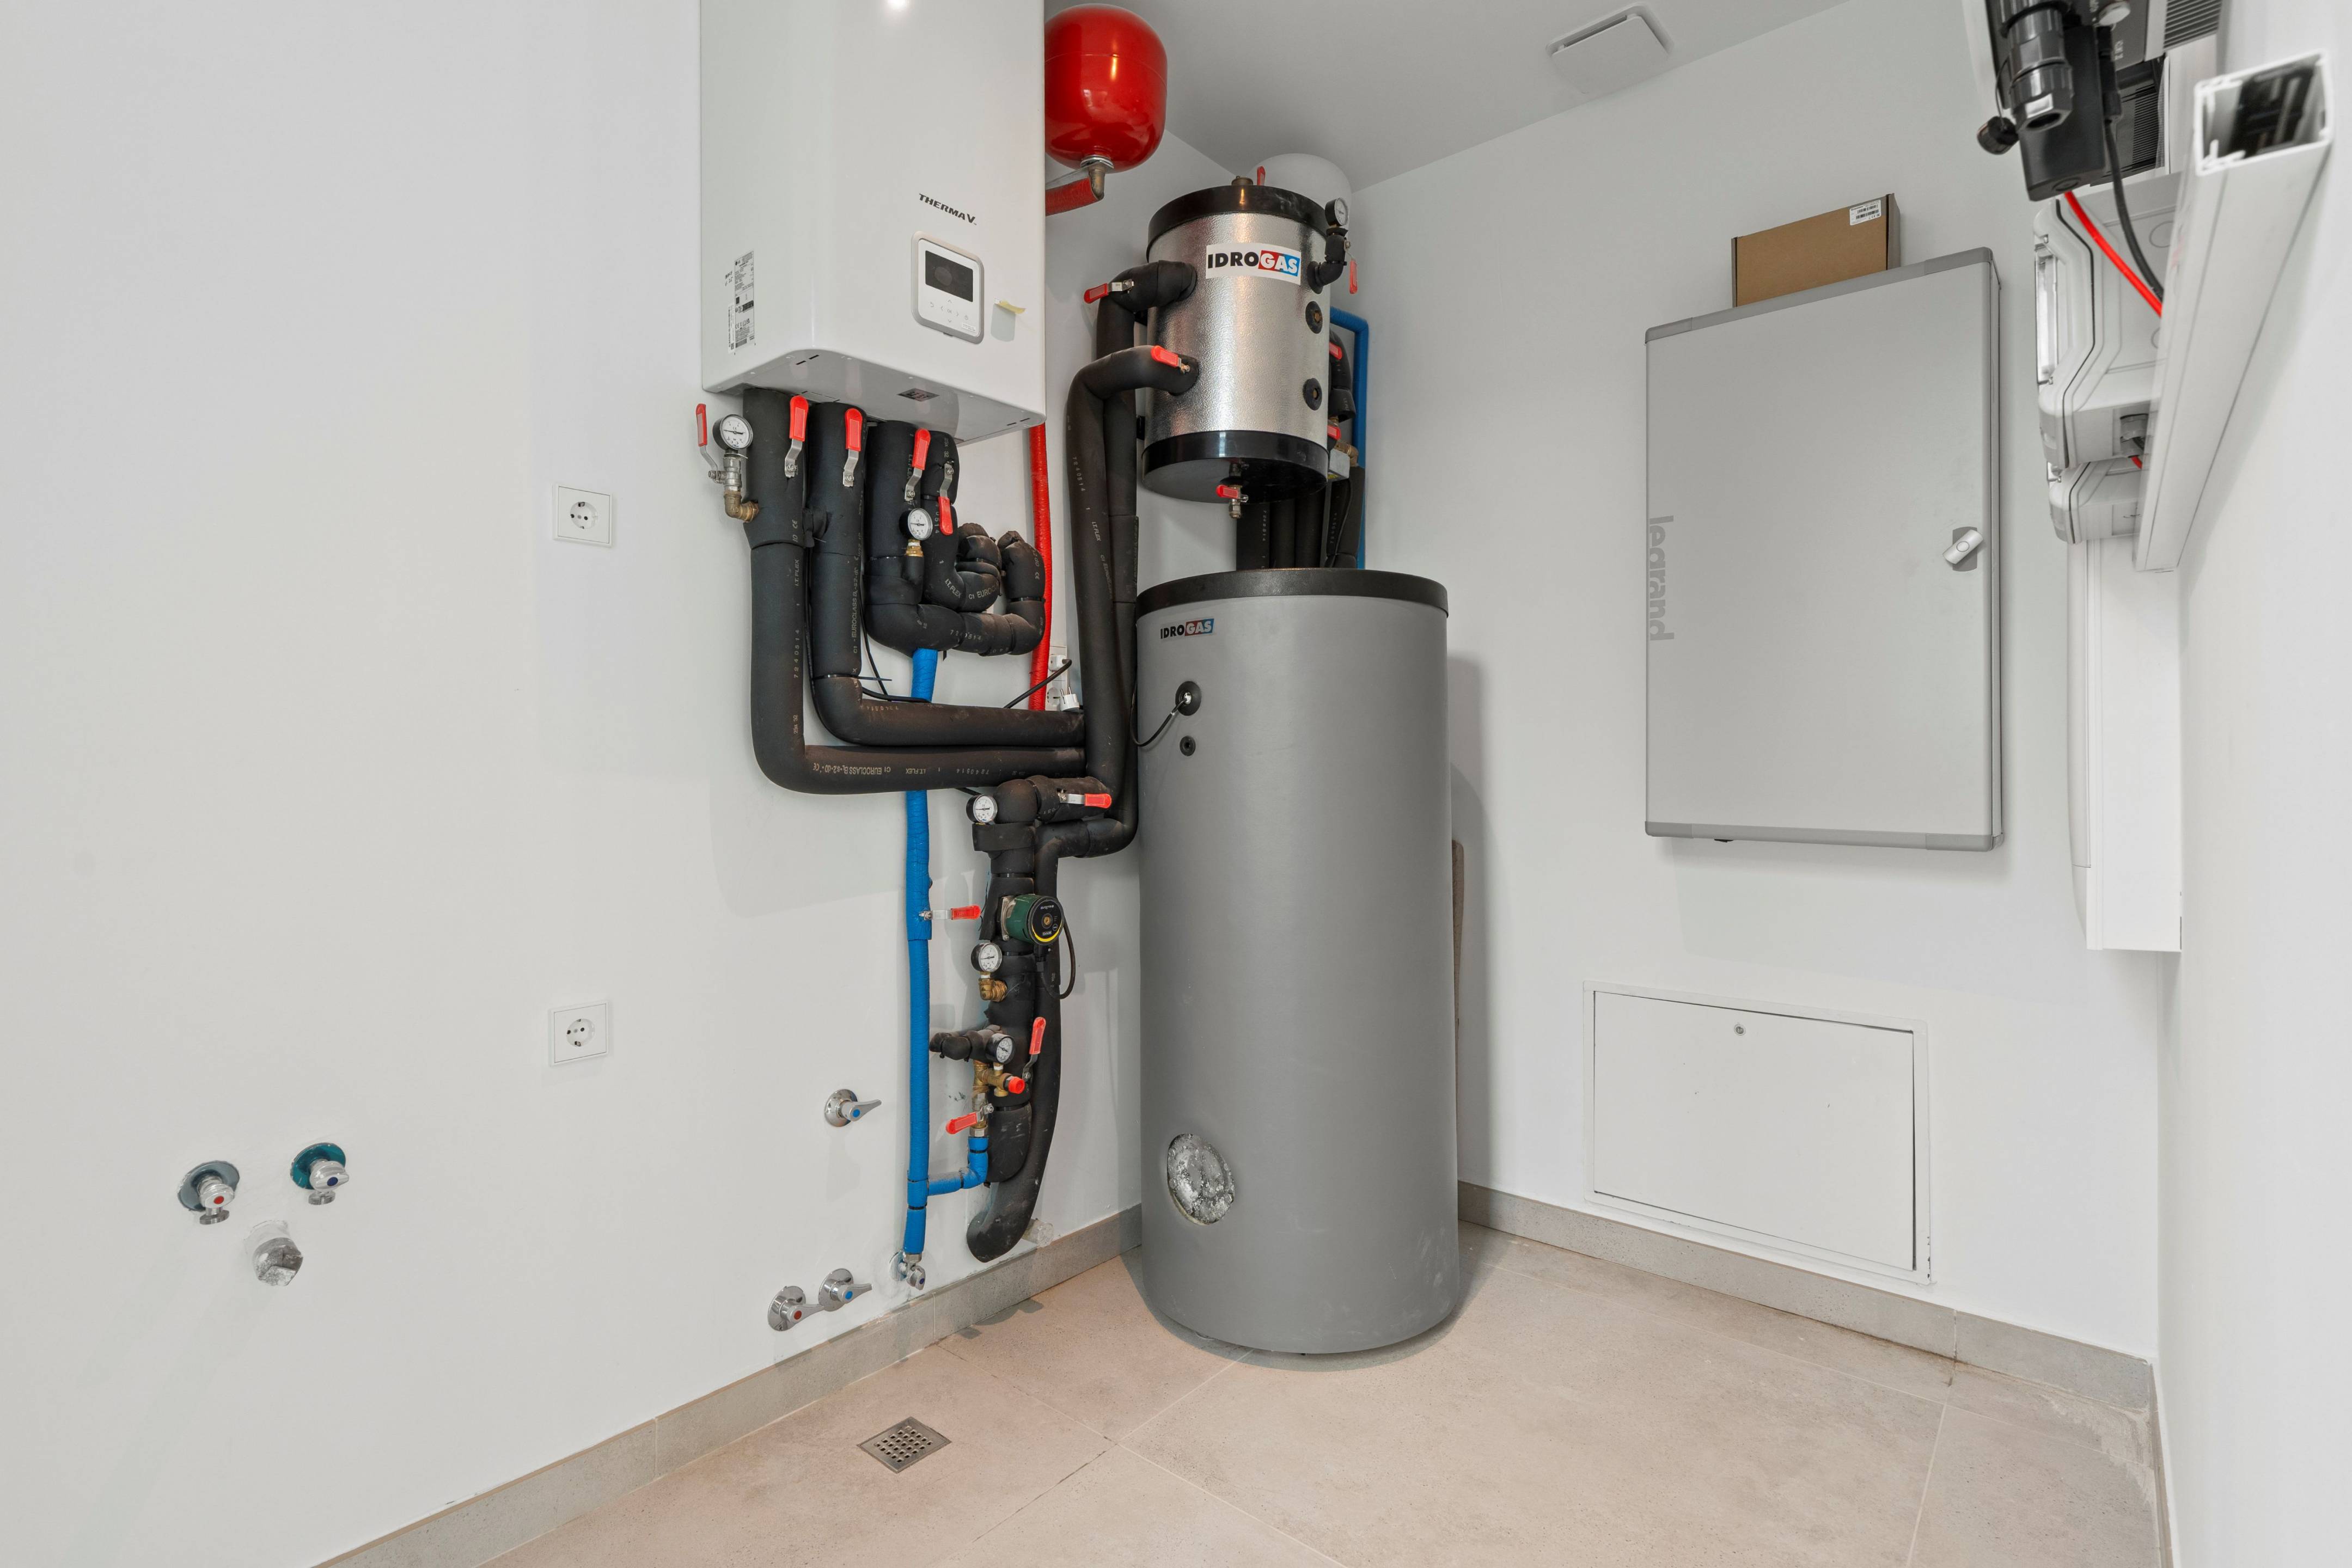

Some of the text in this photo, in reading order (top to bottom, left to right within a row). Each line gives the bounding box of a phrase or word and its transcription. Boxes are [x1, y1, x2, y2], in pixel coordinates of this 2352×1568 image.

[1208, 252, 1298, 274] IDROGAS
[1649, 515, 1675, 641] legrand
[1160, 621, 1212, 639] IDROGAS
[849, 766, 882, 775] EUROCLASS
